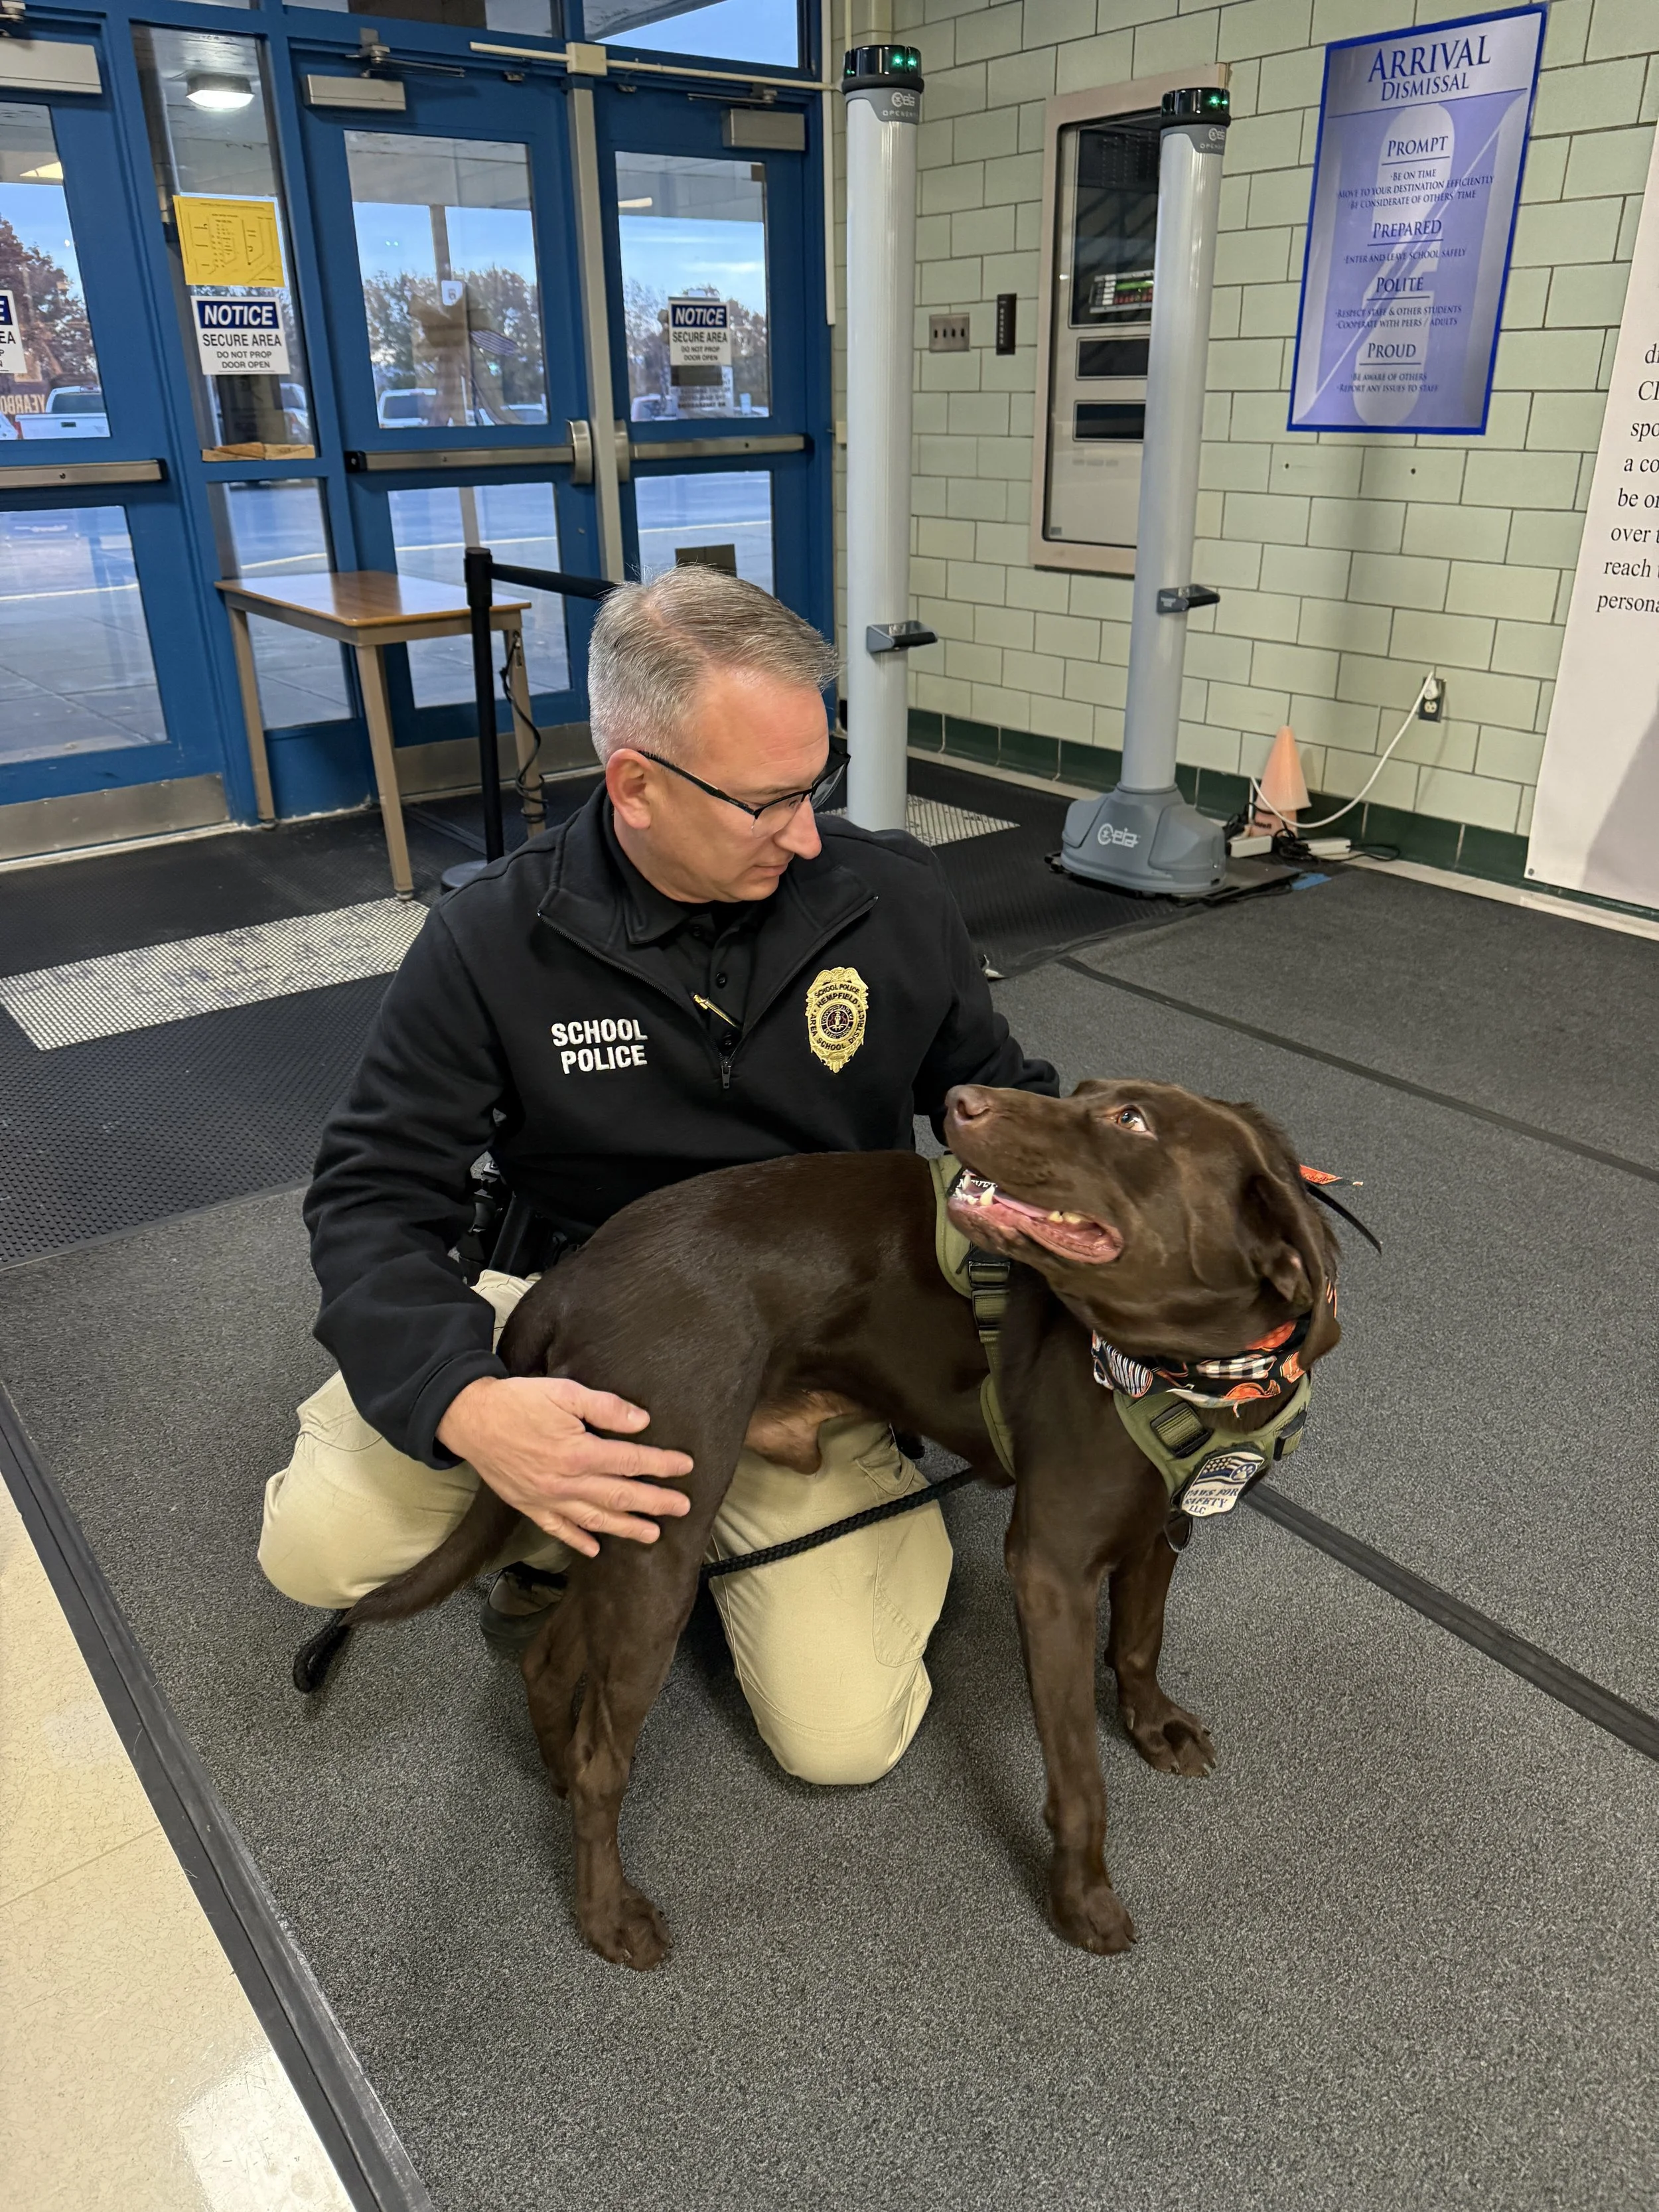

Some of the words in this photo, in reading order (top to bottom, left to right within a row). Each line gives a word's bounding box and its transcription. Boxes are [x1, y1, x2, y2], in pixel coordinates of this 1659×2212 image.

[1368, 35, 1491, 83] ARRIVAL
[1381, 72, 1469, 101] DISMISSAL
[1387, 136, 1448, 157] PROMPT
[1404, 171, 1415, 180] ON
[1418, 169, 1436, 179] TIME
[1360, 188, 1370, 197] TO
[1372, 186, 1392, 196] YOUR
[1394, 181, 1444, 194] DESTINATION
[1447, 175, 1494, 188] EFFICIENTLY
[1360, 197, 1409, 208] CONSIDERATE
[1458, 190, 1476, 200] TIME
[1373, 220, 1442, 239] PREPARED
[1345, 255, 1368, 264] ENTER
[1370, 254, 1386, 262] AND
[1409, 250, 1439, 260] SCHOOL
[1441, 248, 1467, 258] SAFELY
[1376, 277, 1424, 293] POLITE
[204, 305, 273, 325] NOTICE
[675, 307, 725, 325] NOTICE
[1424, 305, 1462, 315] STUDENTS
[1380, 319, 1400, 328] WITH
[1402, 319, 1421, 327] PEERS
[1431, 317, 1457, 326] ADULTS
[202, 334, 249, 346] SECURE
[252, 334, 282, 346] AREA
[672, 332, 705, 342] SECURE
[706, 332, 727, 342] AREA
[1368, 342, 1416, 358] PROUD
[1624, 458, 1633, 472] a
[1618, 487, 1638, 507] be
[1611, 528, 1651, 542] over
[1603, 558, 1651, 577] reach
[815, 984, 839, 998] SCHOOL
[840, 984, 860, 994] POLICE
[816, 993, 858, 1008] HEMPFIELD
[551, 1019, 648, 1047] SCHOOL
[817, 1038, 846, 1051] SCHOOL
[849, 1009, 865, 1045] DISTRICT
[560, 1045, 648, 1074] POLICE
[1183, 1498, 1228, 1509] SAFETY
[1189, 1505, 1206, 1514] LLC
